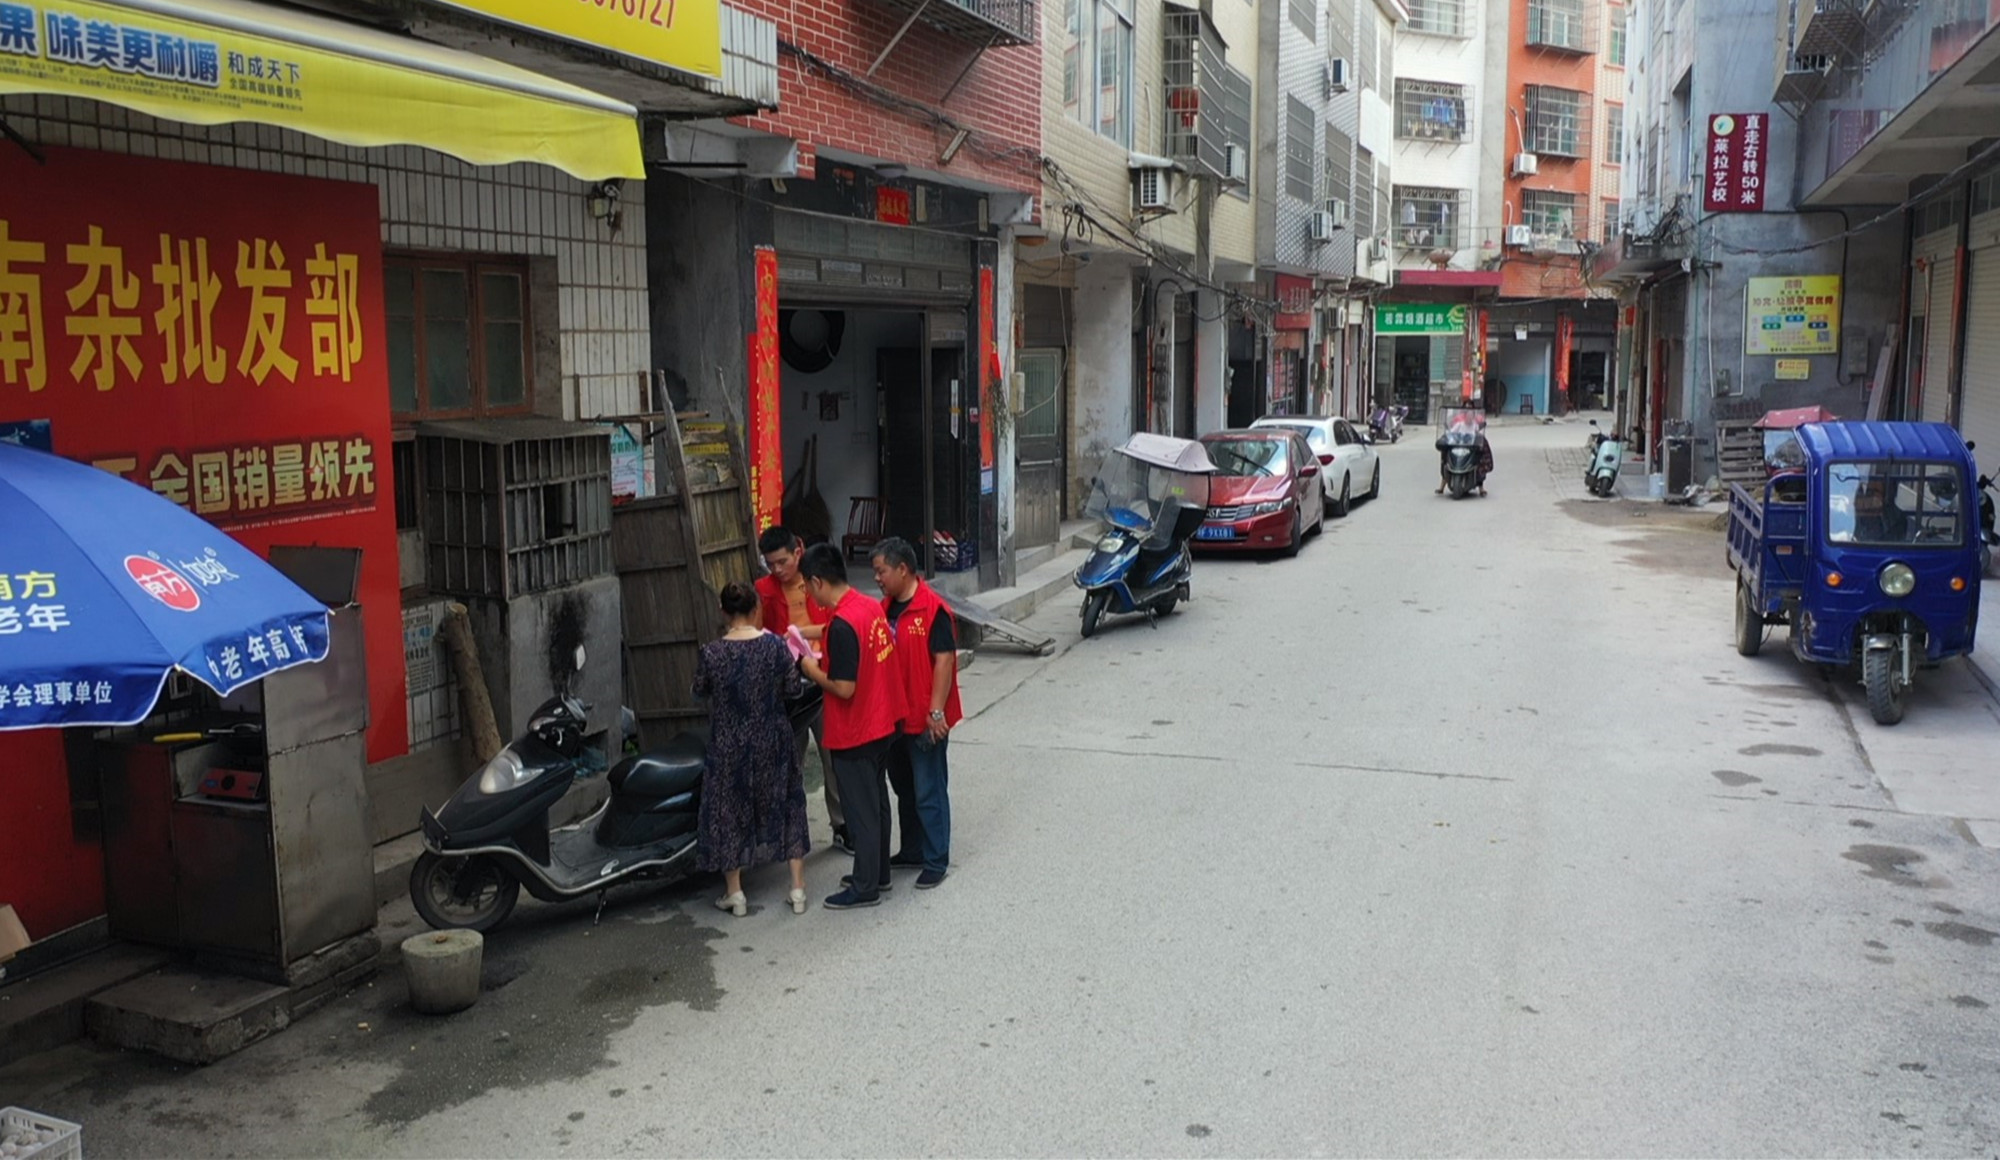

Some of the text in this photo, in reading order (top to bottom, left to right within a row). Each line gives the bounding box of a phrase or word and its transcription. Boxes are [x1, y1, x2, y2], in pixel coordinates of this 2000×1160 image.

[0, 4, 219, 84] 果 味美更耐嚼
[228, 51, 300, 84] 和成天下
[1741, 115, 1760, 204] 直走右转50米
[0, 220, 362, 392] 南杂批发部
[0, 681, 112, 709] 学会理事单位
